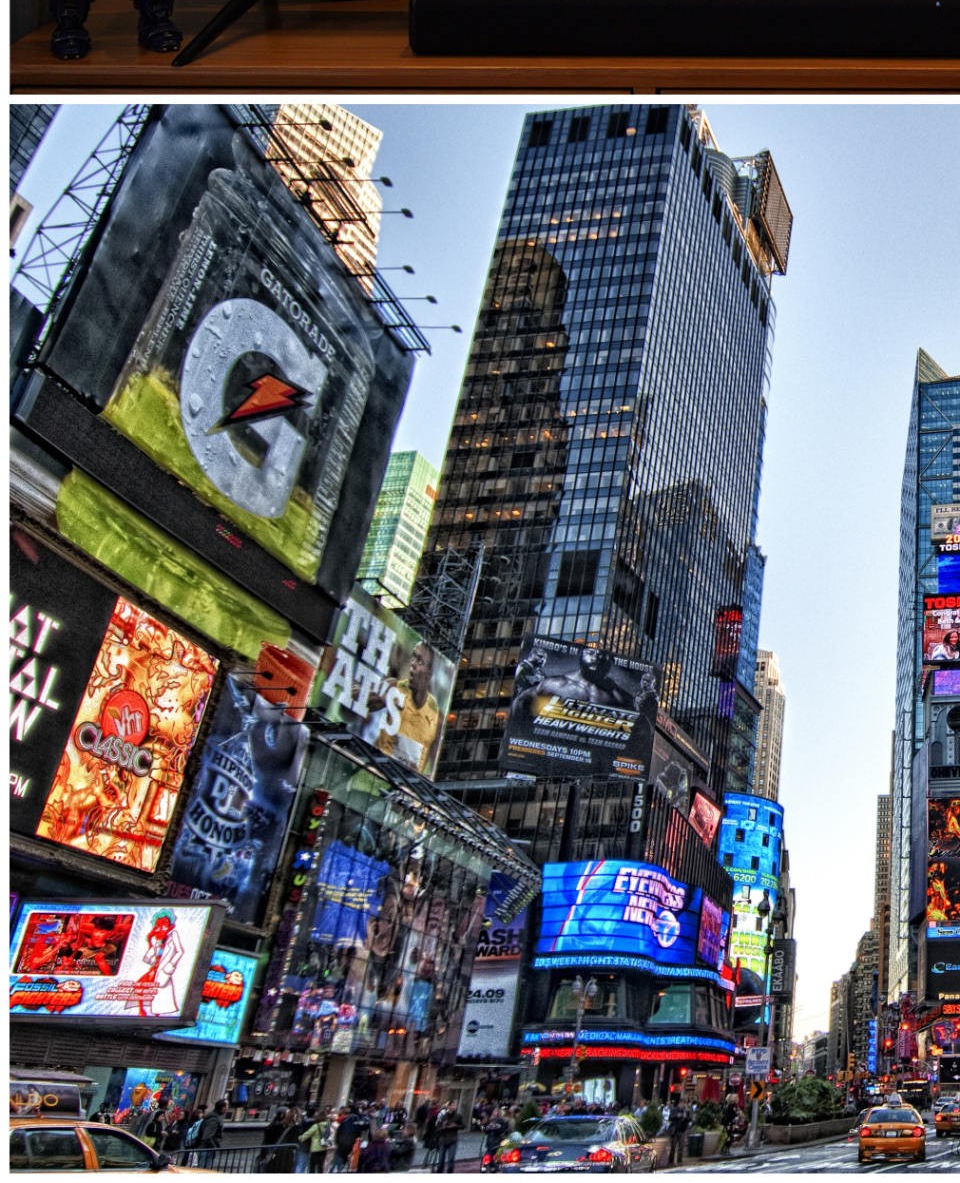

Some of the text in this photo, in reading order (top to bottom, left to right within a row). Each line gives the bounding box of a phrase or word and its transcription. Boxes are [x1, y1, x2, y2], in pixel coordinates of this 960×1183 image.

[259, 267, 338, 363] GATORADE
[9, 594, 60, 655] AT
[533, 638, 654, 672] KIMBO'S IN THE HOUSE
[533, 716, 630, 741] HEAVYWEIGHTS
[75, 721, 154, 777] CLASSIC
[509, 738, 591, 758] WEDNESDAYS 10PM
[612, 760, 645, 771] SPIKE
[629, 783, 643, 833] 1500
[733, 873, 757, 884] 6200
[773, 950, 785, 992] EKAABO
